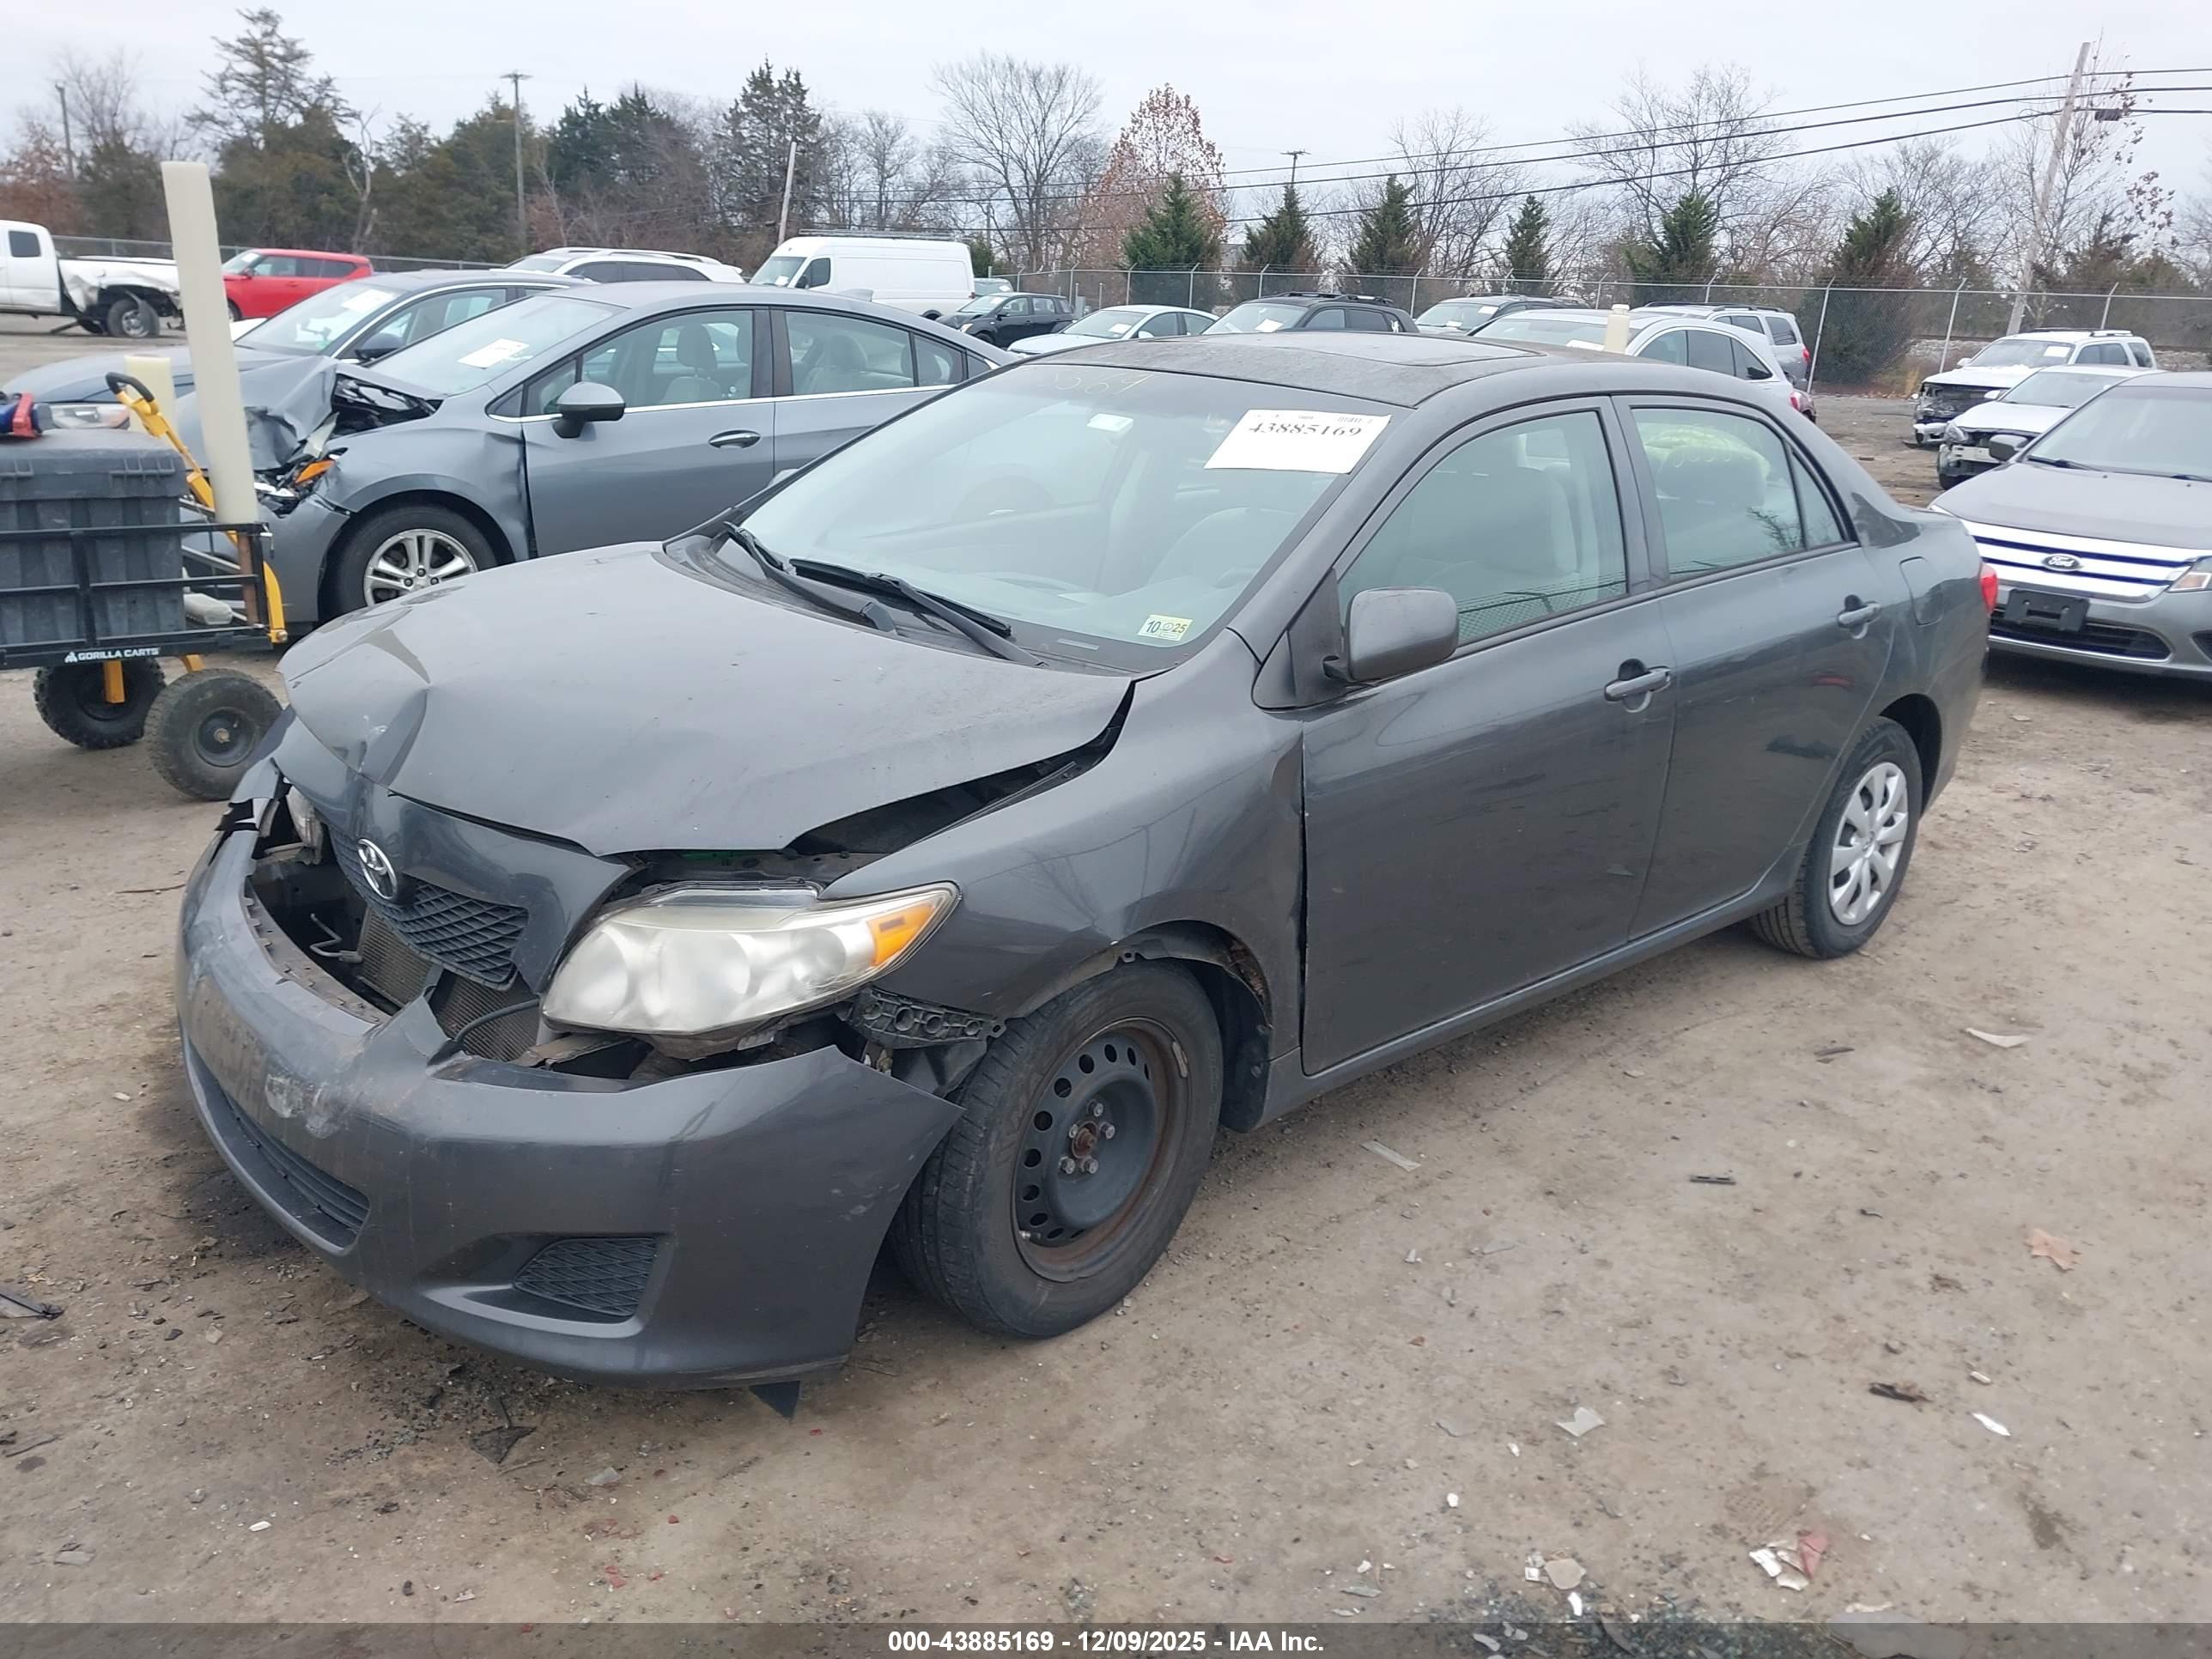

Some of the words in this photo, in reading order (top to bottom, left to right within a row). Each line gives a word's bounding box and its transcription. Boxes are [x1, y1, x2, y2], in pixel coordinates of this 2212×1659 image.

[1249, 422, 1363, 437] 43885169
[2047, 555, 2076, 568] Ford
[1146, 620, 1162, 633] 10
[1172, 623, 1188, 634] 25
[77, 650, 123, 661] GORILLA
[123, 647, 160, 658] CARTS
